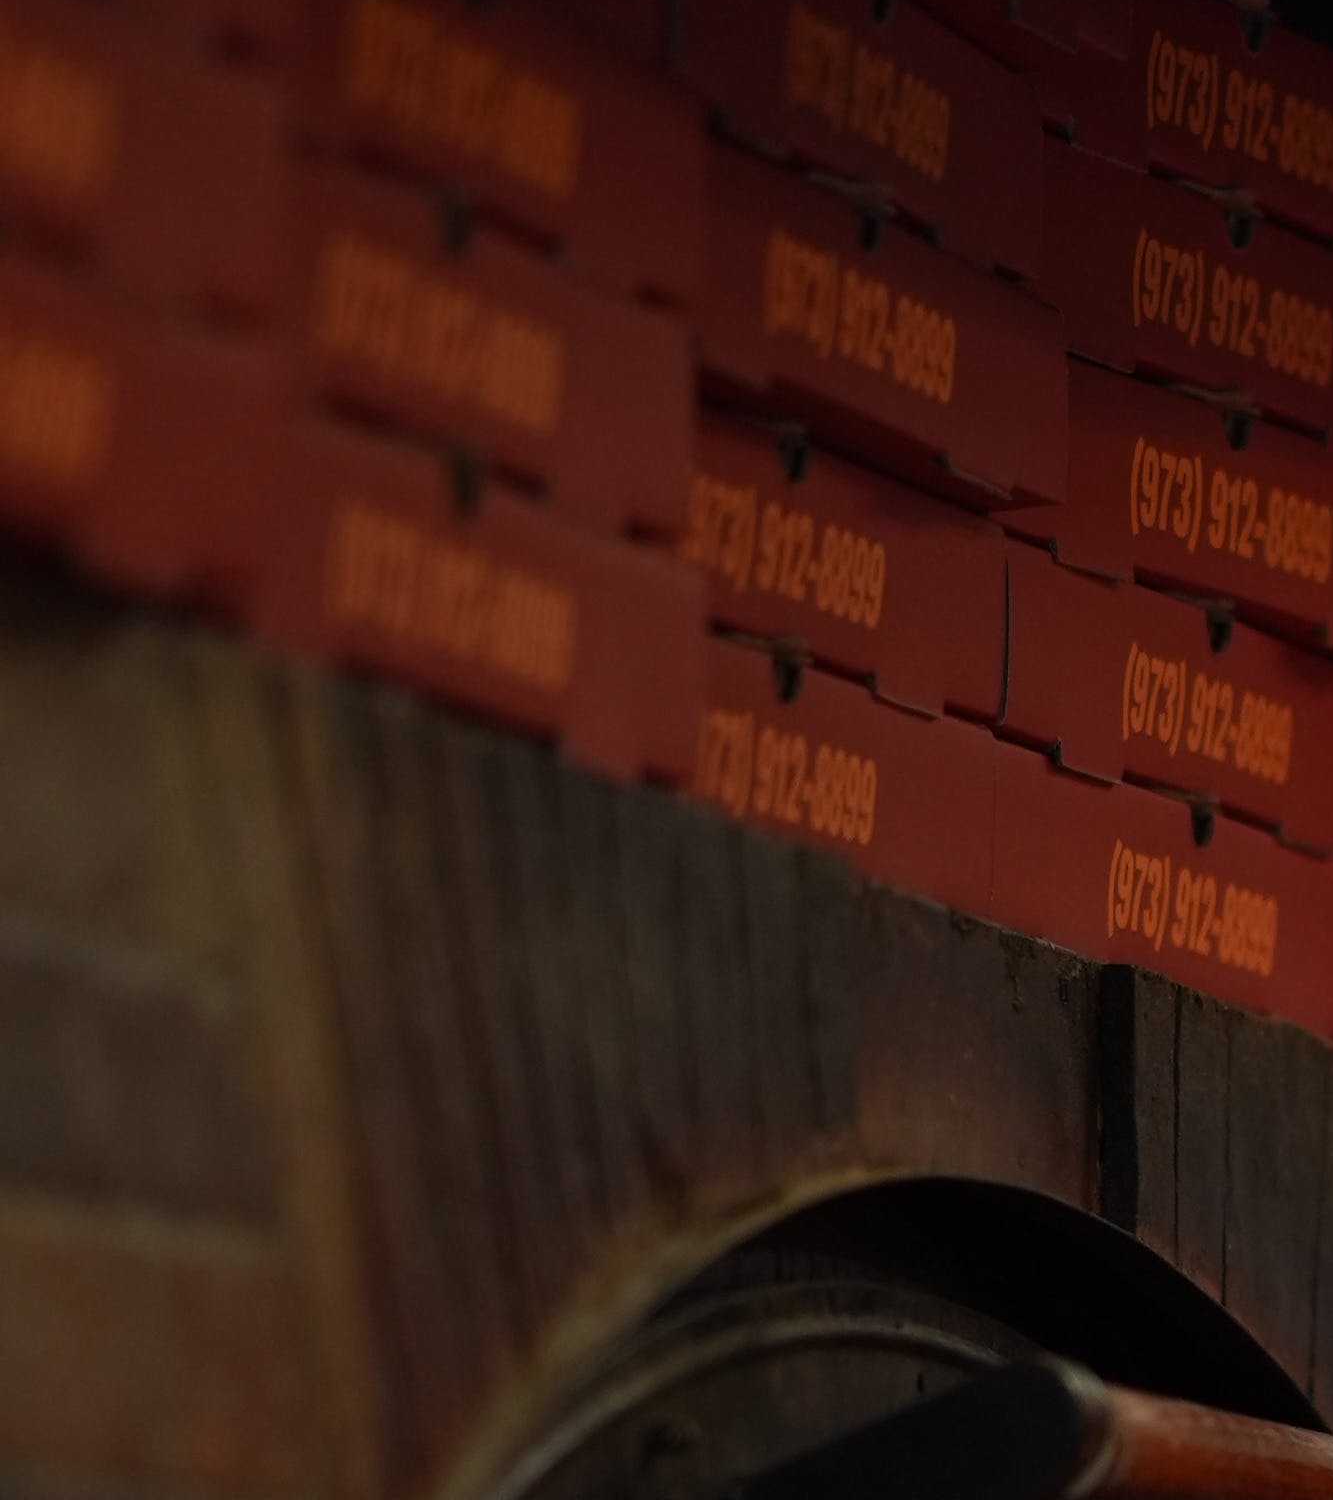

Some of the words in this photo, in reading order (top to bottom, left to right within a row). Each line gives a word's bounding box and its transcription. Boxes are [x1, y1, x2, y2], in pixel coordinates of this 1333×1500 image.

[1146, 30, 1217, 151] (973)
[1133, 228, 1204, 346] (973)
[758, 501, 886, 628] 912-8899
[1131, 436, 1203, 553] (973)
[1208, 470, 1333, 583] 912-8899
[1121, 642, 1185, 756] (973)
[756, 725, 877, 845] 912-8899
[1106, 840, 1170, 951] (973)
